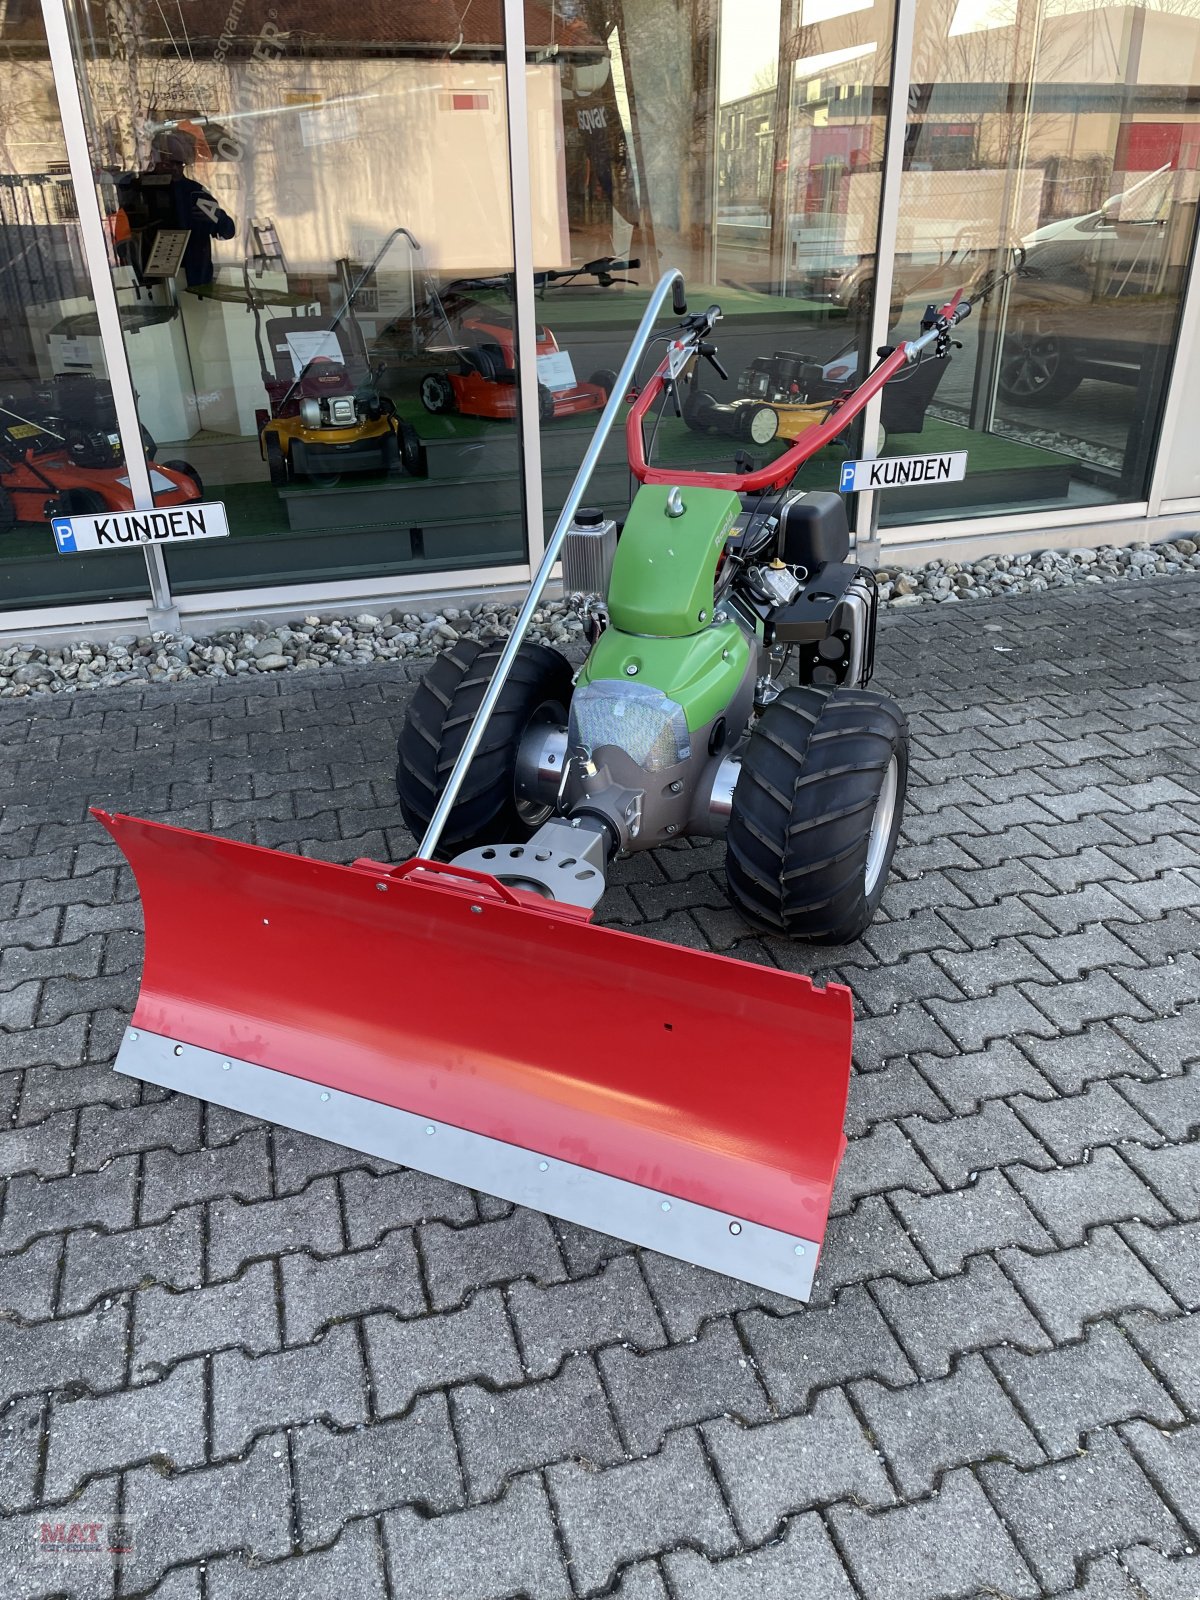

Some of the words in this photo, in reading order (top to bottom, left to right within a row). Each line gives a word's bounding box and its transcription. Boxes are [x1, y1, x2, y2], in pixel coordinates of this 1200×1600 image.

[842, 468, 855, 486] P
[870, 457, 952, 485] KUNDEN
[56, 525, 73, 546] P
[94, 509, 207, 545] KUNDEN
